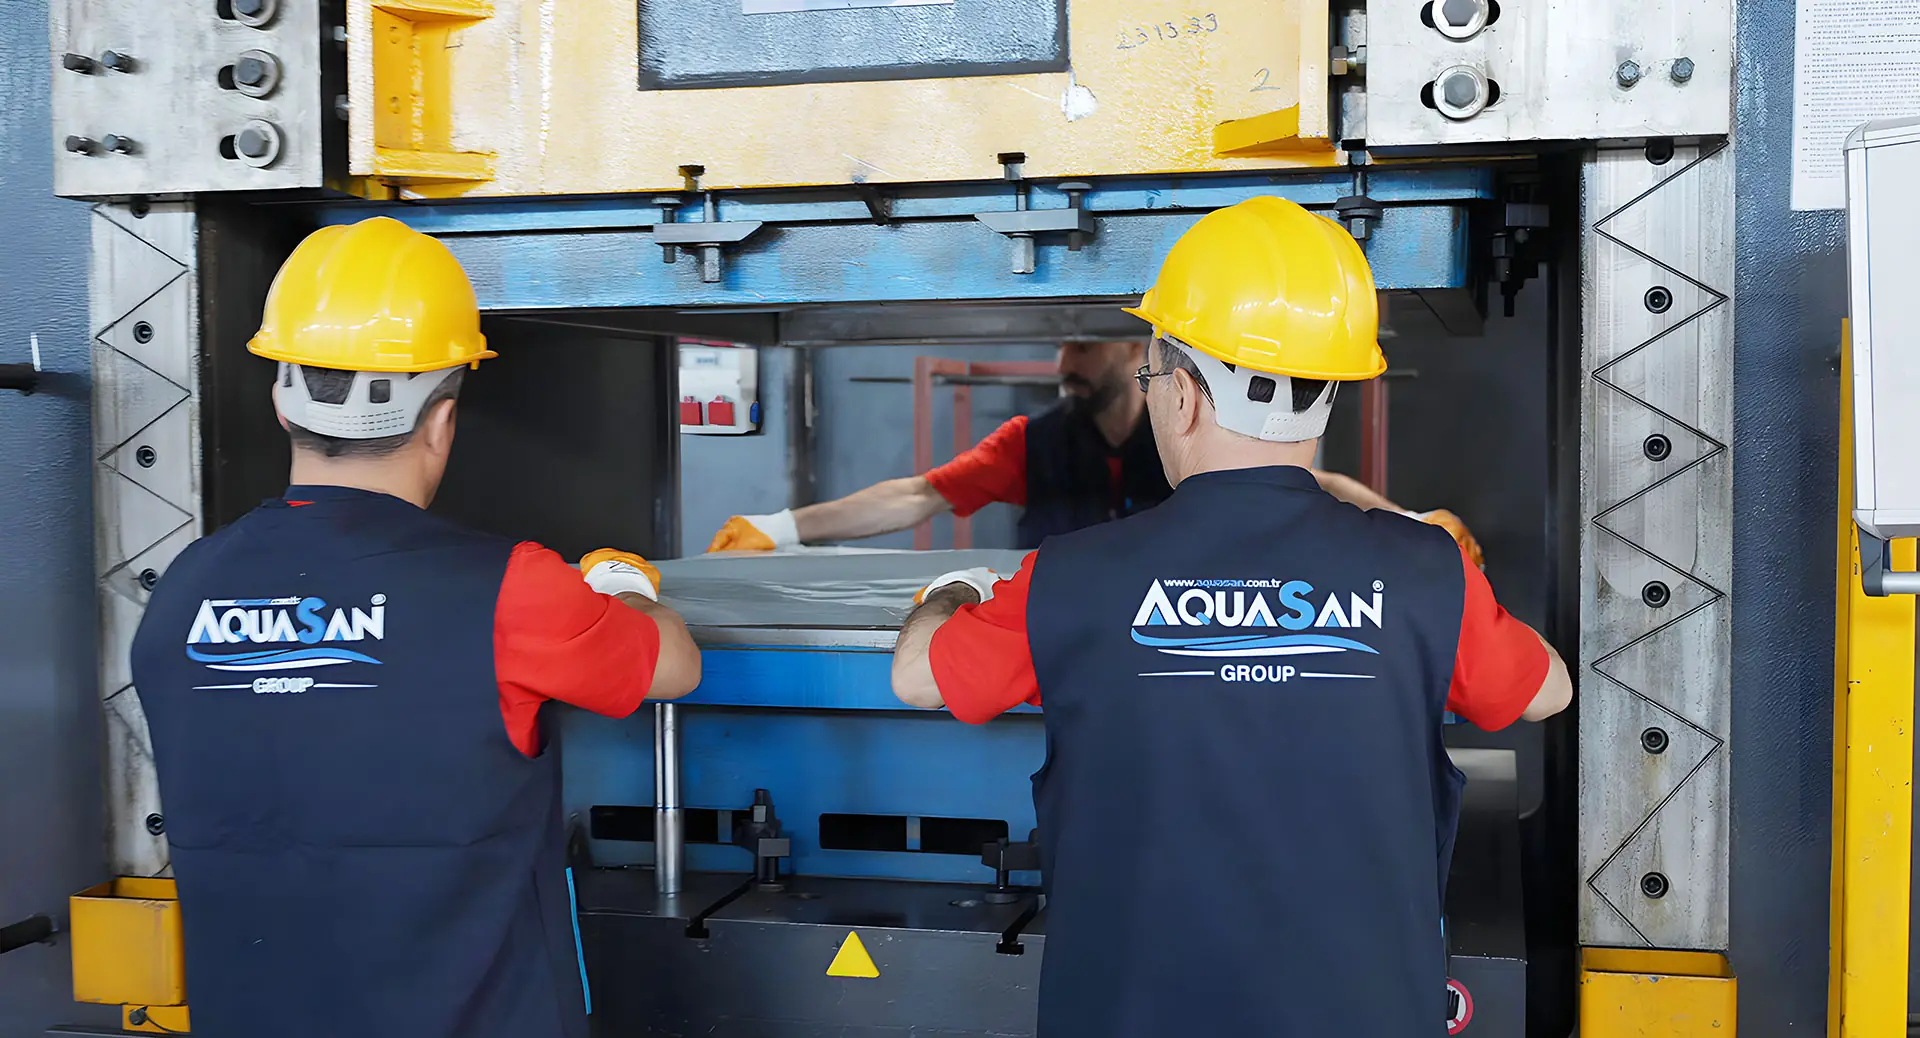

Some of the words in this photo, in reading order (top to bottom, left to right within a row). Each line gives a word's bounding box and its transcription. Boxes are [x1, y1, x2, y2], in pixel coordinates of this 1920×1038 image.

[1250, 68, 1280, 92] 2
[186, 597, 385, 644] AQUASAN
[1131, 578, 1383, 631] AQUASAN
[1220, 665, 1296, 682] GROUP
